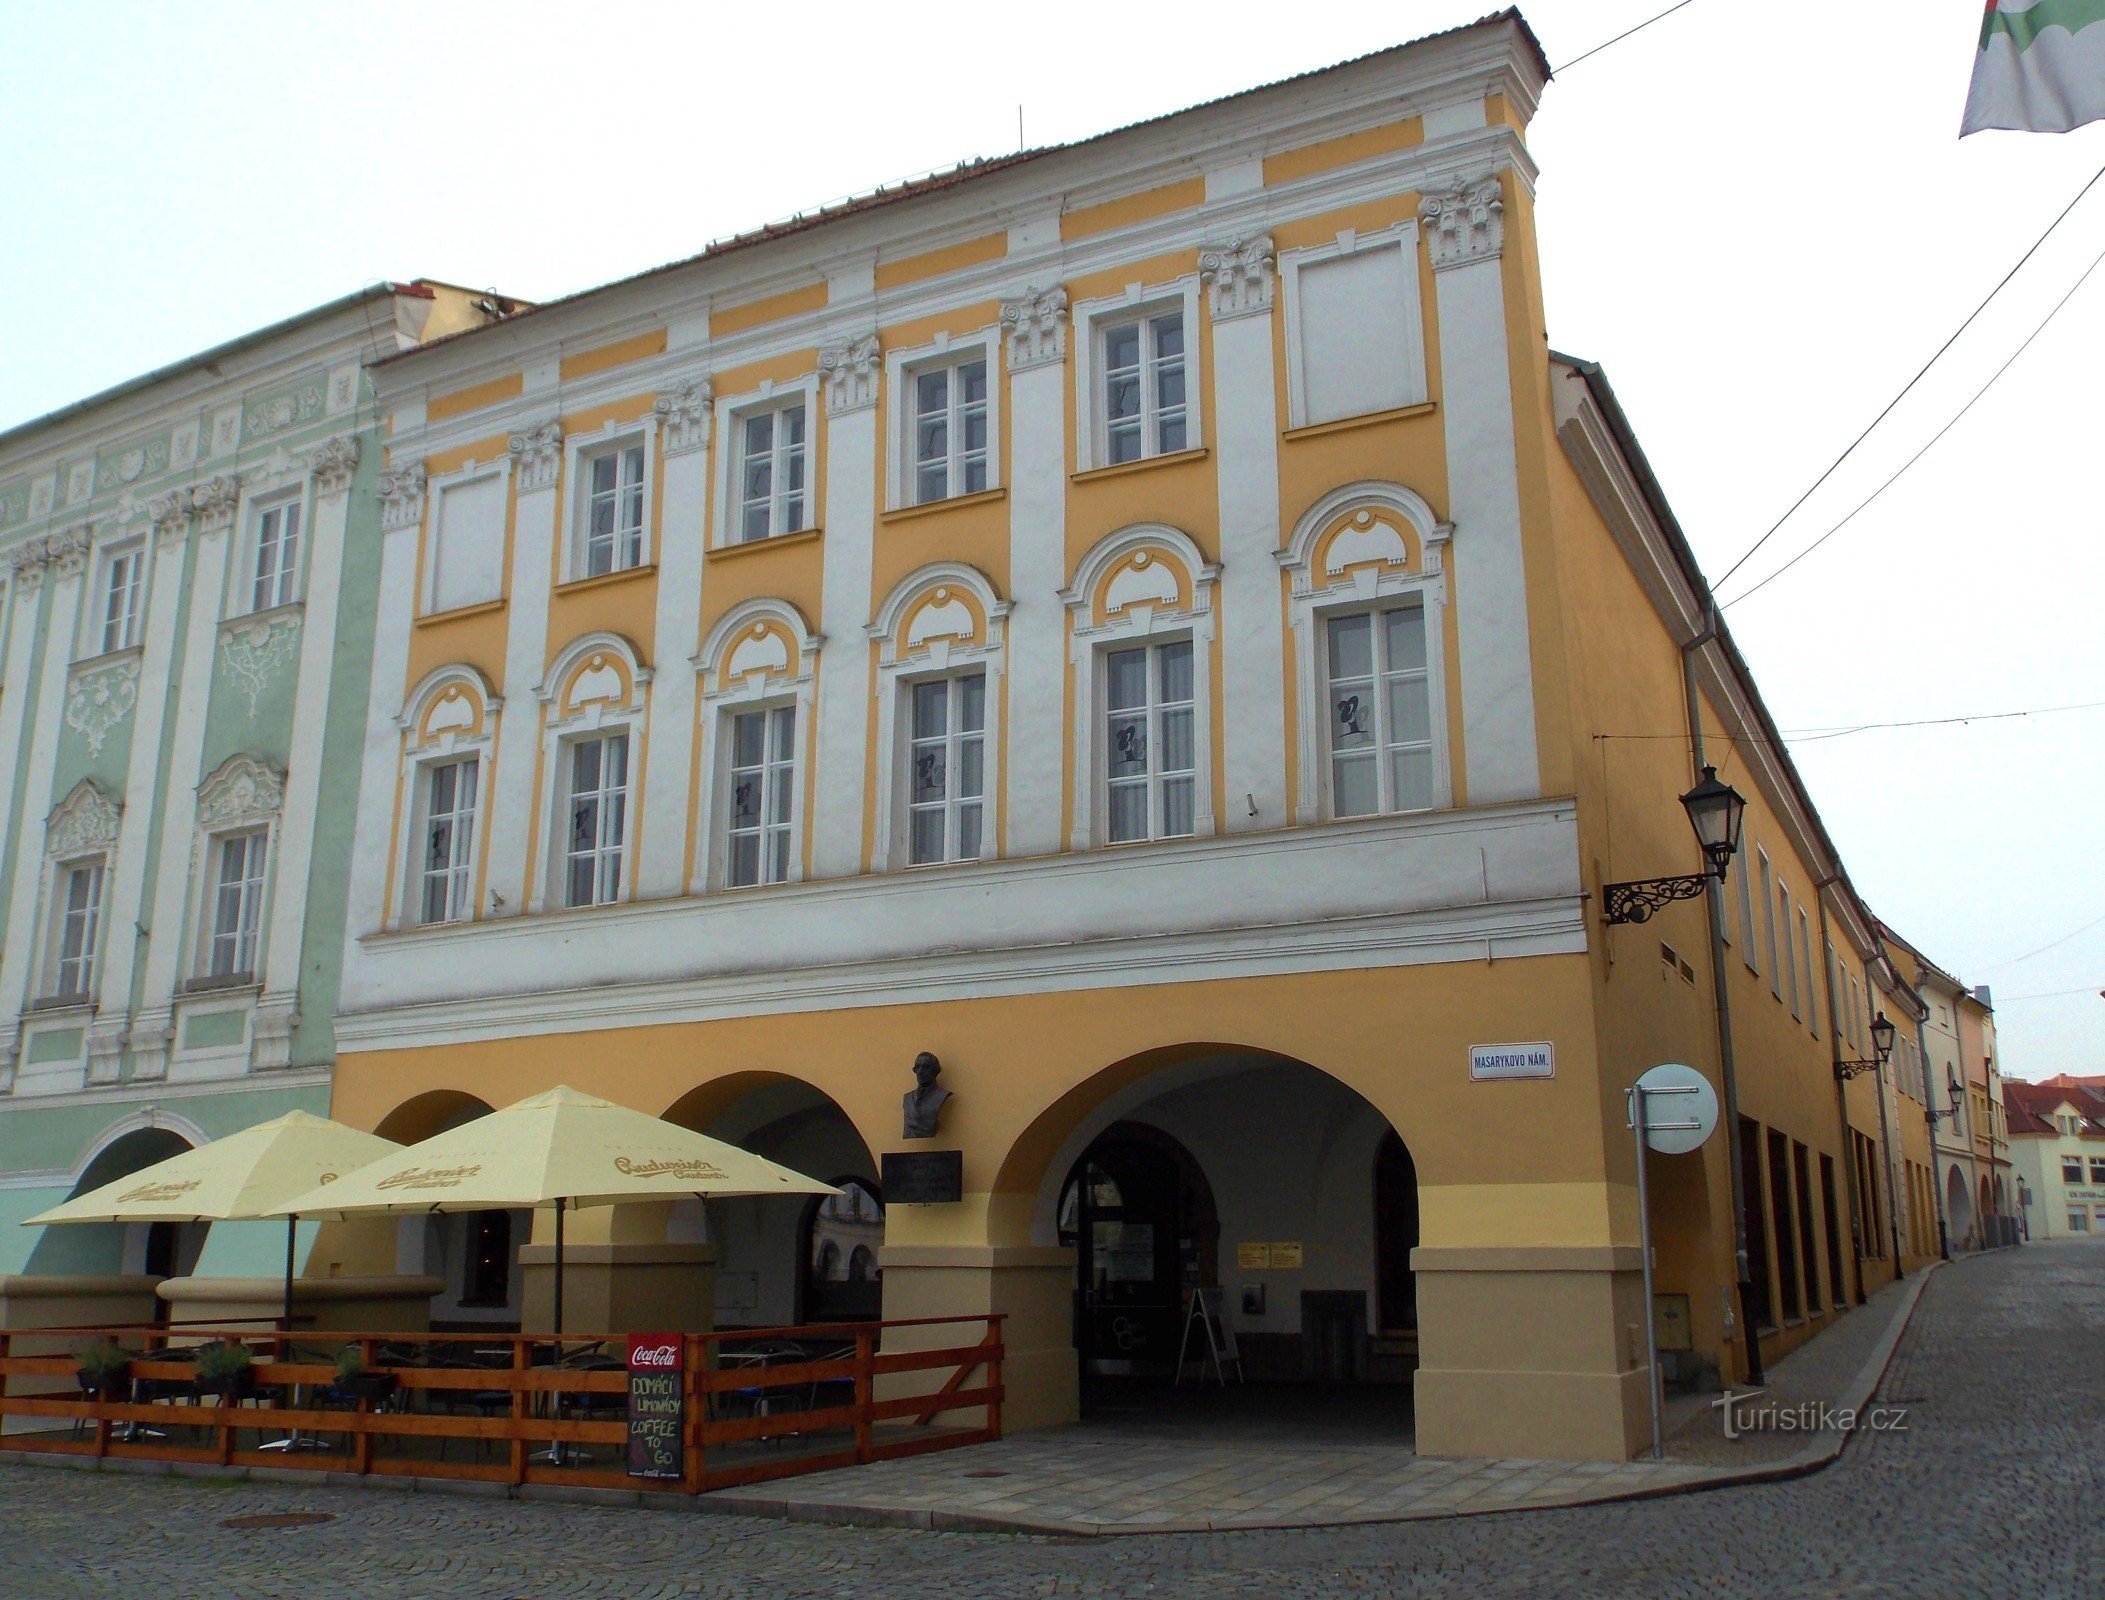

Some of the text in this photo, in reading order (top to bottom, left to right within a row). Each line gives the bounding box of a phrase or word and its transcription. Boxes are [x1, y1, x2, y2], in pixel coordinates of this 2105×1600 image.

[1474, 1051, 1549, 1069] MASARYKOVO NÁM.
[614, 1156, 722, 1178] Budweiser
[631, 1419, 677, 1437] COFFEE
[645, 1435, 661, 1448] TO
[654, 1449, 673, 1465] GO
